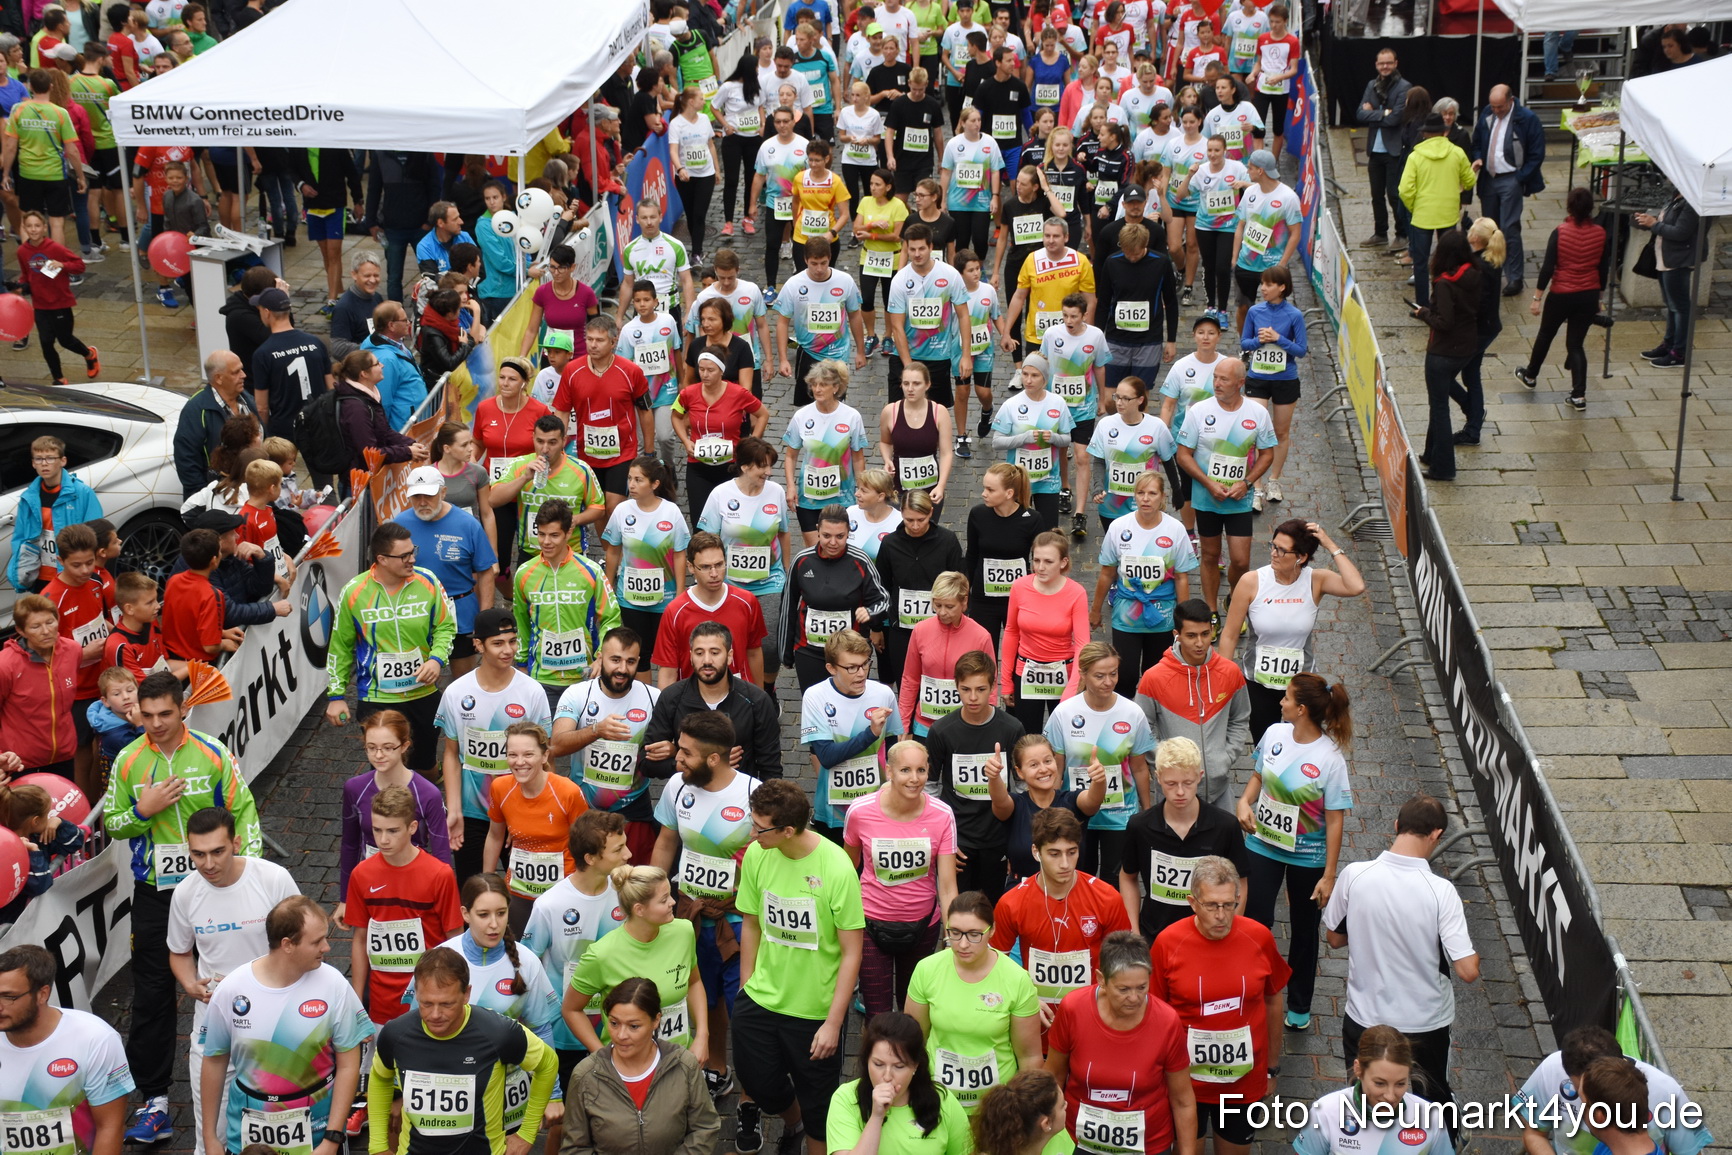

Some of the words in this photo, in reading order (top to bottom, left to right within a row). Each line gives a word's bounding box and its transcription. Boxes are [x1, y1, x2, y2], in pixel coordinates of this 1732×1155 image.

[1038, 89, 1058, 99] 5050
[131, 104, 185, 121] BMW
[189, 104, 345, 122] ConnectedDrive
[133, 124, 195, 138] Vernetzt,
[198, 126, 219, 136] um
[222, 124, 243, 136] frei
[246, 126, 262, 137] zu
[265, 125, 297, 137] sein.
[907, 133, 928, 144] 5019
[686, 150, 706, 160] 5007
[958, 169, 982, 180] 5034
[1054, 192, 1072, 204] 049
[1209, 196, 1232, 208] 5141
[804, 216, 828, 228] 5252
[1016, 221, 1042, 234] 5272
[1246, 224, 1269, 244] 5097
[867, 256, 891, 268] 5145
[1037, 273, 1055, 284] MAX
[1058, 267, 1082, 280] BÖGL
[811, 310, 838, 322] 5231
[912, 305, 940, 317] 5232
[1118, 308, 1147, 321] 5162
[272, 350, 285, 358] The
[286, 348, 300, 358] way
[639, 350, 667, 365] 4034
[1255, 350, 1283, 363] 5183
[1054, 382, 1084, 396] 5165
[587, 434, 616, 448] 5128
[698, 444, 730, 458] 5127
[904, 463, 935, 479] 5193
[1212, 463, 1244, 479] 5186
[807, 473, 837, 488] 5192
[1117, 484, 1135, 493] Jessic
[731, 554, 767, 570] 5320
[987, 567, 1023, 584] 5268
[1125, 564, 1162, 581] 5005
[627, 576, 662, 593] 5030
[528, 589, 587, 605] BOCK
[632, 594, 656, 602] Vanessa
[361, 601, 430, 624] BOCK
[810, 618, 848, 634] 5152
[545, 638, 582, 657] 2870
[383, 660, 422, 679] 2835
[1260, 655, 1300, 675] 5104
[1026, 669, 1065, 686] 5018
[1269, 675, 1287, 685] Petra
[924, 685, 961, 705] 5135
[1034, 686, 1056, 695] Isabell
[480, 760, 496, 770] Obai
[589, 749, 633, 773] 5262
[595, 772, 620, 785] Khaled
[833, 766, 876, 788] 5065
[724, 808, 744, 820] Hervis
[1257, 803, 1293, 834] 5248
[1261, 826, 1282, 843] Sevinc
[878, 850, 927, 870] 5093
[514, 860, 559, 883] 5090
[684, 862, 730, 891] 5202
[888, 870, 916, 882] Andrea
[767, 903, 812, 931] 5194
[195, 915, 243, 935] RÖDL
[370, 931, 420, 953] 5166
[781, 930, 797, 942] Alex
[378, 955, 414, 967] Jonathan
[1034, 962, 1087, 984] 5002
[302, 1003, 326, 1016] Hervis
[1213, 1001, 1231, 1011] DEHN
[1194, 1041, 1249, 1065] 5084
[50, 1061, 75, 1074] Hervis
[1208, 1066, 1233, 1077] Frank
[940, 1063, 994, 1089] 5190
[410, 1087, 469, 1114] 5156
[956, 1091, 978, 1101] Julia
[1099, 1092, 1119, 1100] DEHN
[418, 1116, 457, 1129] Andreas
[6, 1121, 65, 1149] 5081
[248, 1122, 307, 1146] 5064
[1082, 1120, 1139, 1147] 5085
[1401, 1130, 1425, 1143] Hervis
[1338, 1138, 1361, 1147] PARTL
